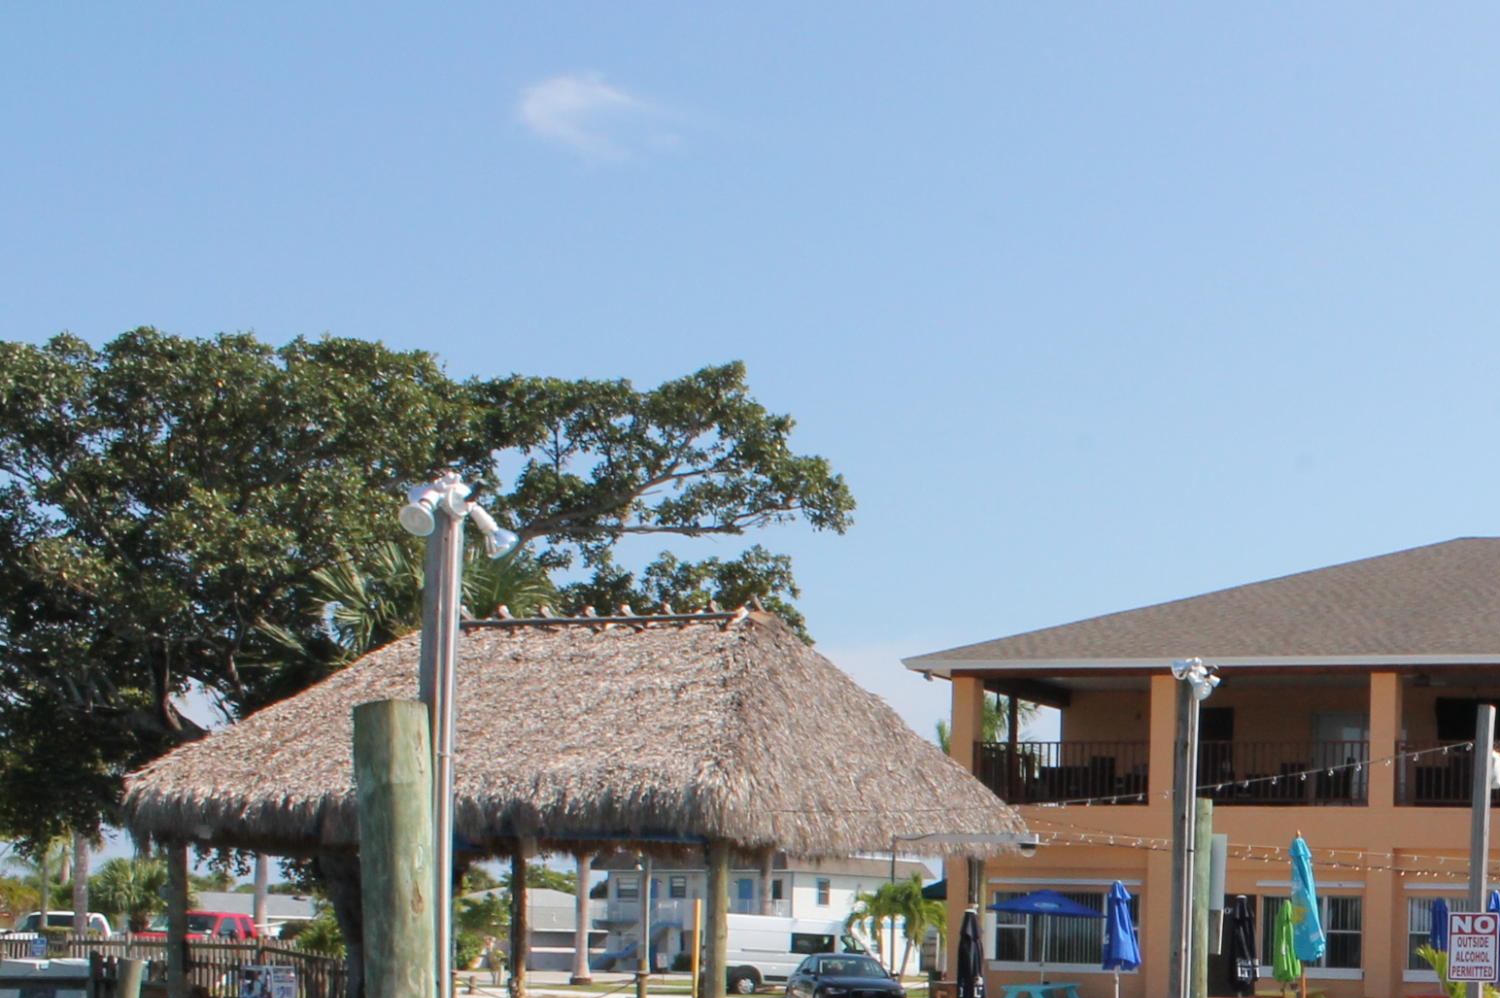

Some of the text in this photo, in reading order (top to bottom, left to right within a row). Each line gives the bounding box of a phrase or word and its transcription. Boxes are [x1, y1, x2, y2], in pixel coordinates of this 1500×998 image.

[1451, 915, 1495, 934] NO
[1457, 936, 1489, 948] OUTSIDE
[1456, 951, 1490, 962] ALCOHOL
[1451, 965, 1493, 977] PERMITTED
